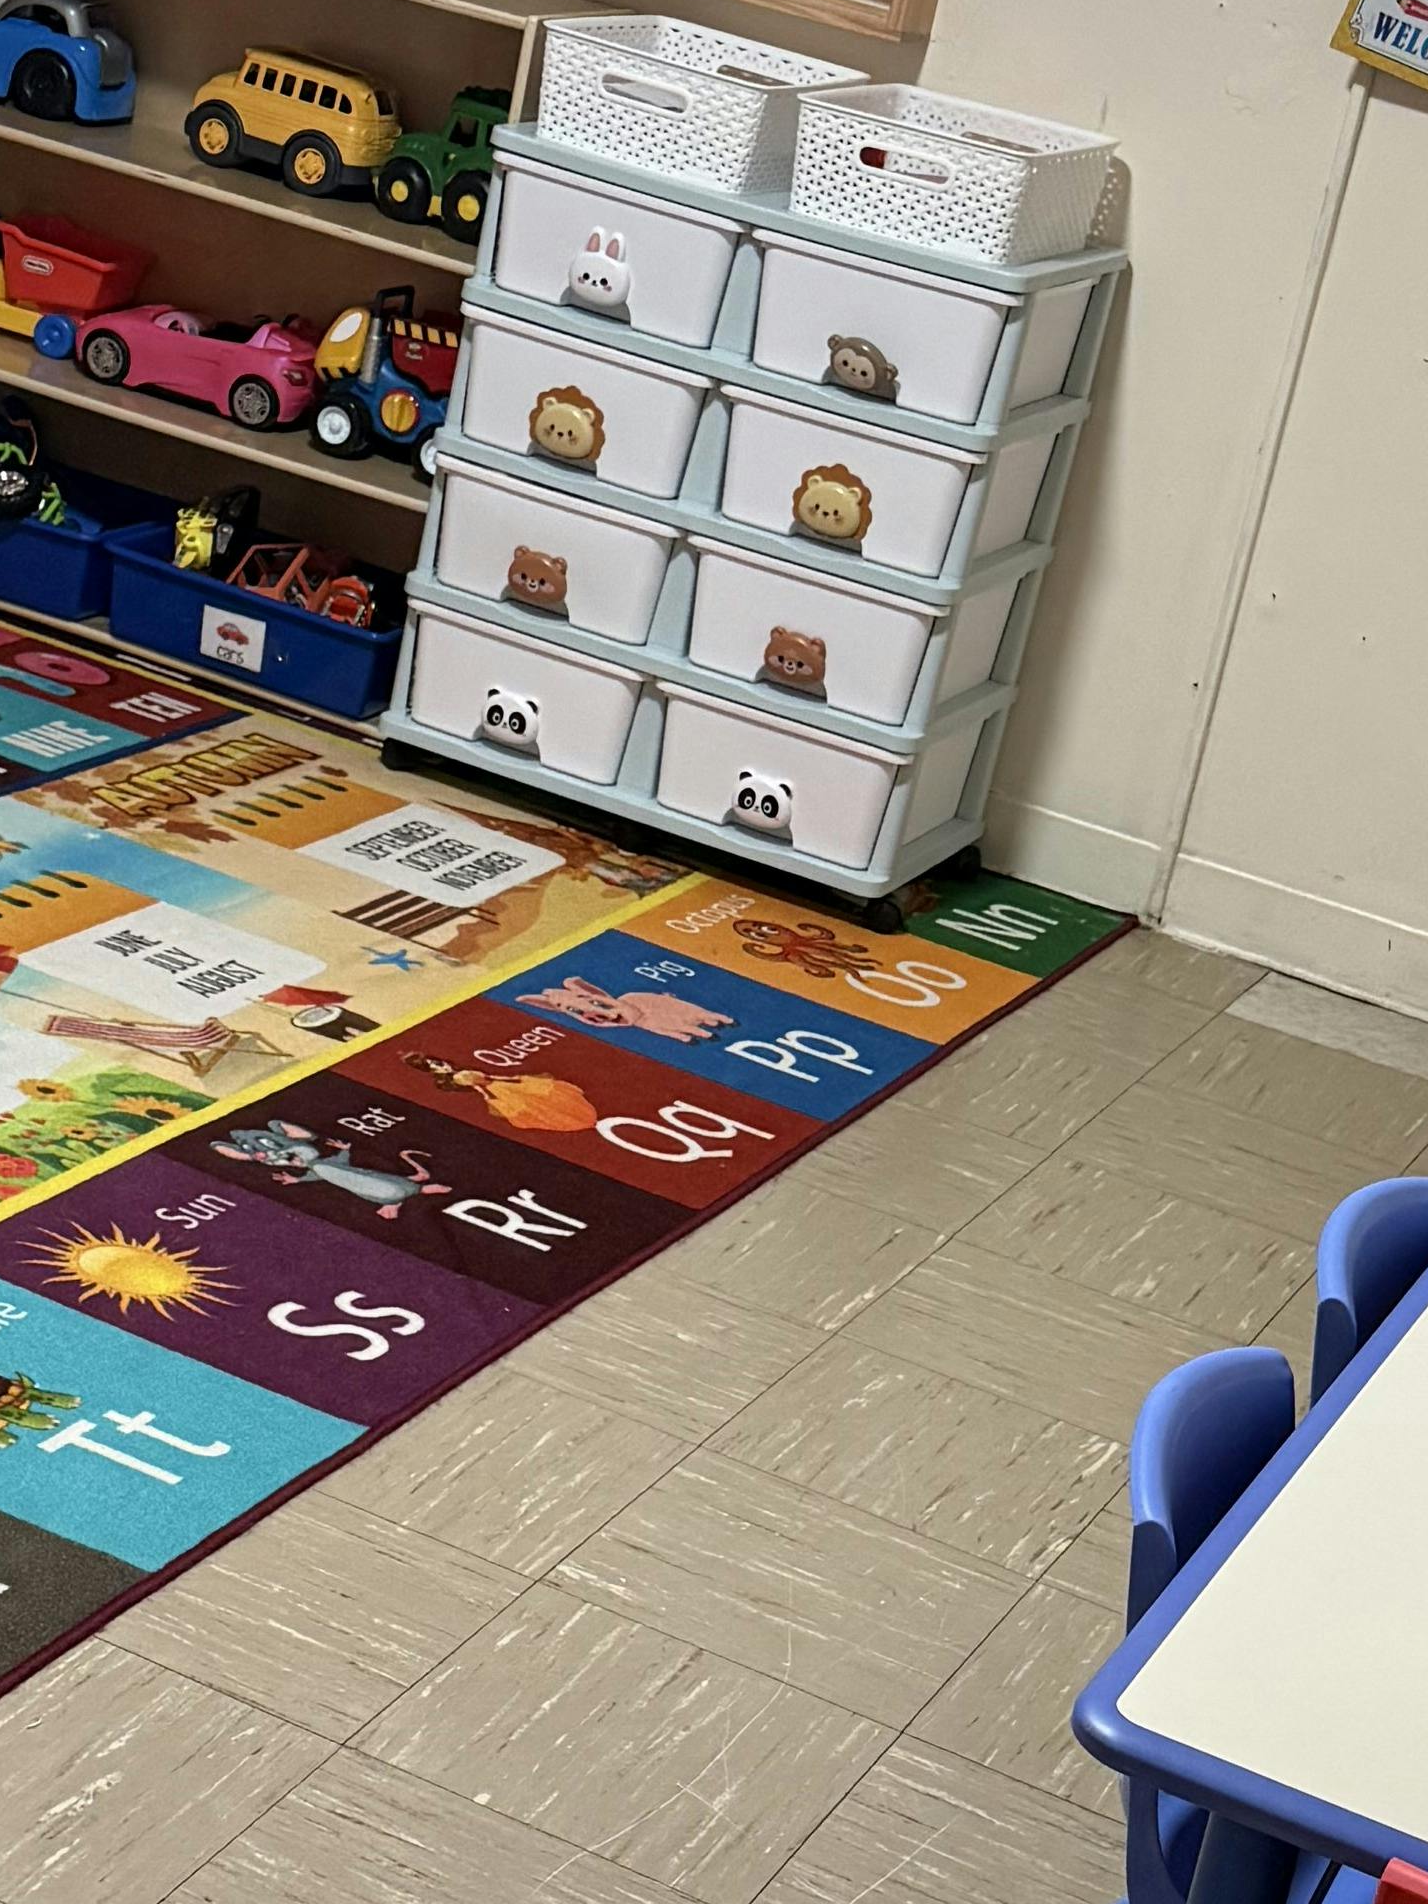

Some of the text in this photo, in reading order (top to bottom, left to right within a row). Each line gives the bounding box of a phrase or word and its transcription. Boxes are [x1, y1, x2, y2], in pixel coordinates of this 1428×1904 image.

[216, 644, 245, 665] cars
[109, 690, 202, 722] TEN
[0, 718, 113, 761] NINE
[92, 731, 324, 821] AUTUMN
[342, 818, 449, 860] SEPTEMBER
[392, 836, 472, 875] OCTOBER
[429, 850, 528, 891] NOVEMBER
[665, 893, 757, 936] Octopus
[933, 902, 1061, 953] Nn
[92, 925, 157, 961] JUNE
[143, 946, 206, 978] JULY
[176, 958, 267, 1000] AUGUST
[634, 956, 696, 985] Pig
[842, 959, 969, 1010] Oo
[472, 1021, 566, 1070] Queen
[724, 1026, 875, 1085] Pp
[338, 1104, 406, 1142] Rat
[594, 1098, 777, 1166] Qq
[154, 1189, 237, 1232] Sun
[442, 1183, 587, 1253] Rr
[267, 1289, 426, 1362] Ss
[36, 1409, 232, 1486] Tt
